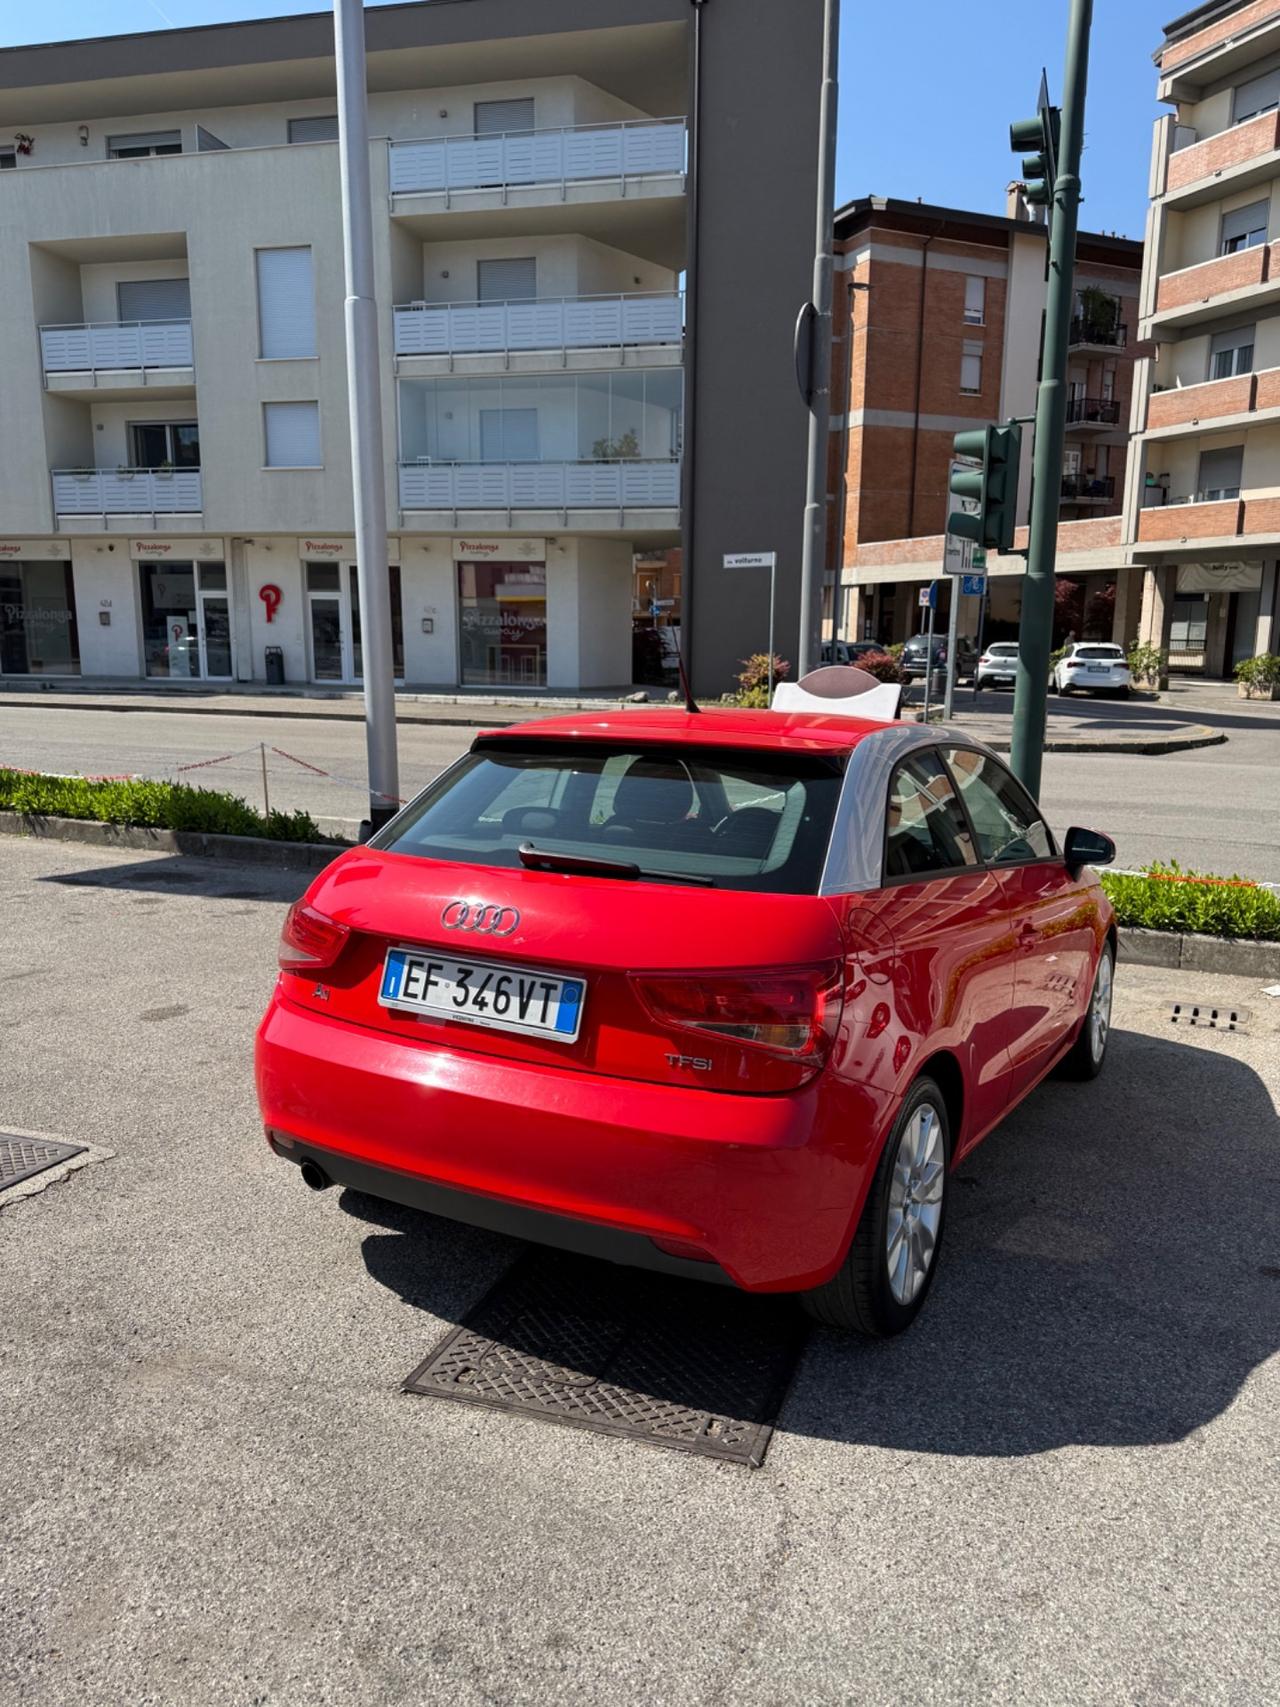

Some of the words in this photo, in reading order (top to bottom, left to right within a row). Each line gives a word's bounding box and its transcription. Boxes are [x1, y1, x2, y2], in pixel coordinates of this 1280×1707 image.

[136, 542, 171, 552] Pizzalonga
[305, 541, 343, 552] Pizzalonga
[460, 541, 499, 552] Pizzalonga
[403, 959, 444, 1001] EF
[452, 967, 559, 1024] 346VT
[664, 1053, 713, 1071] TFSI
